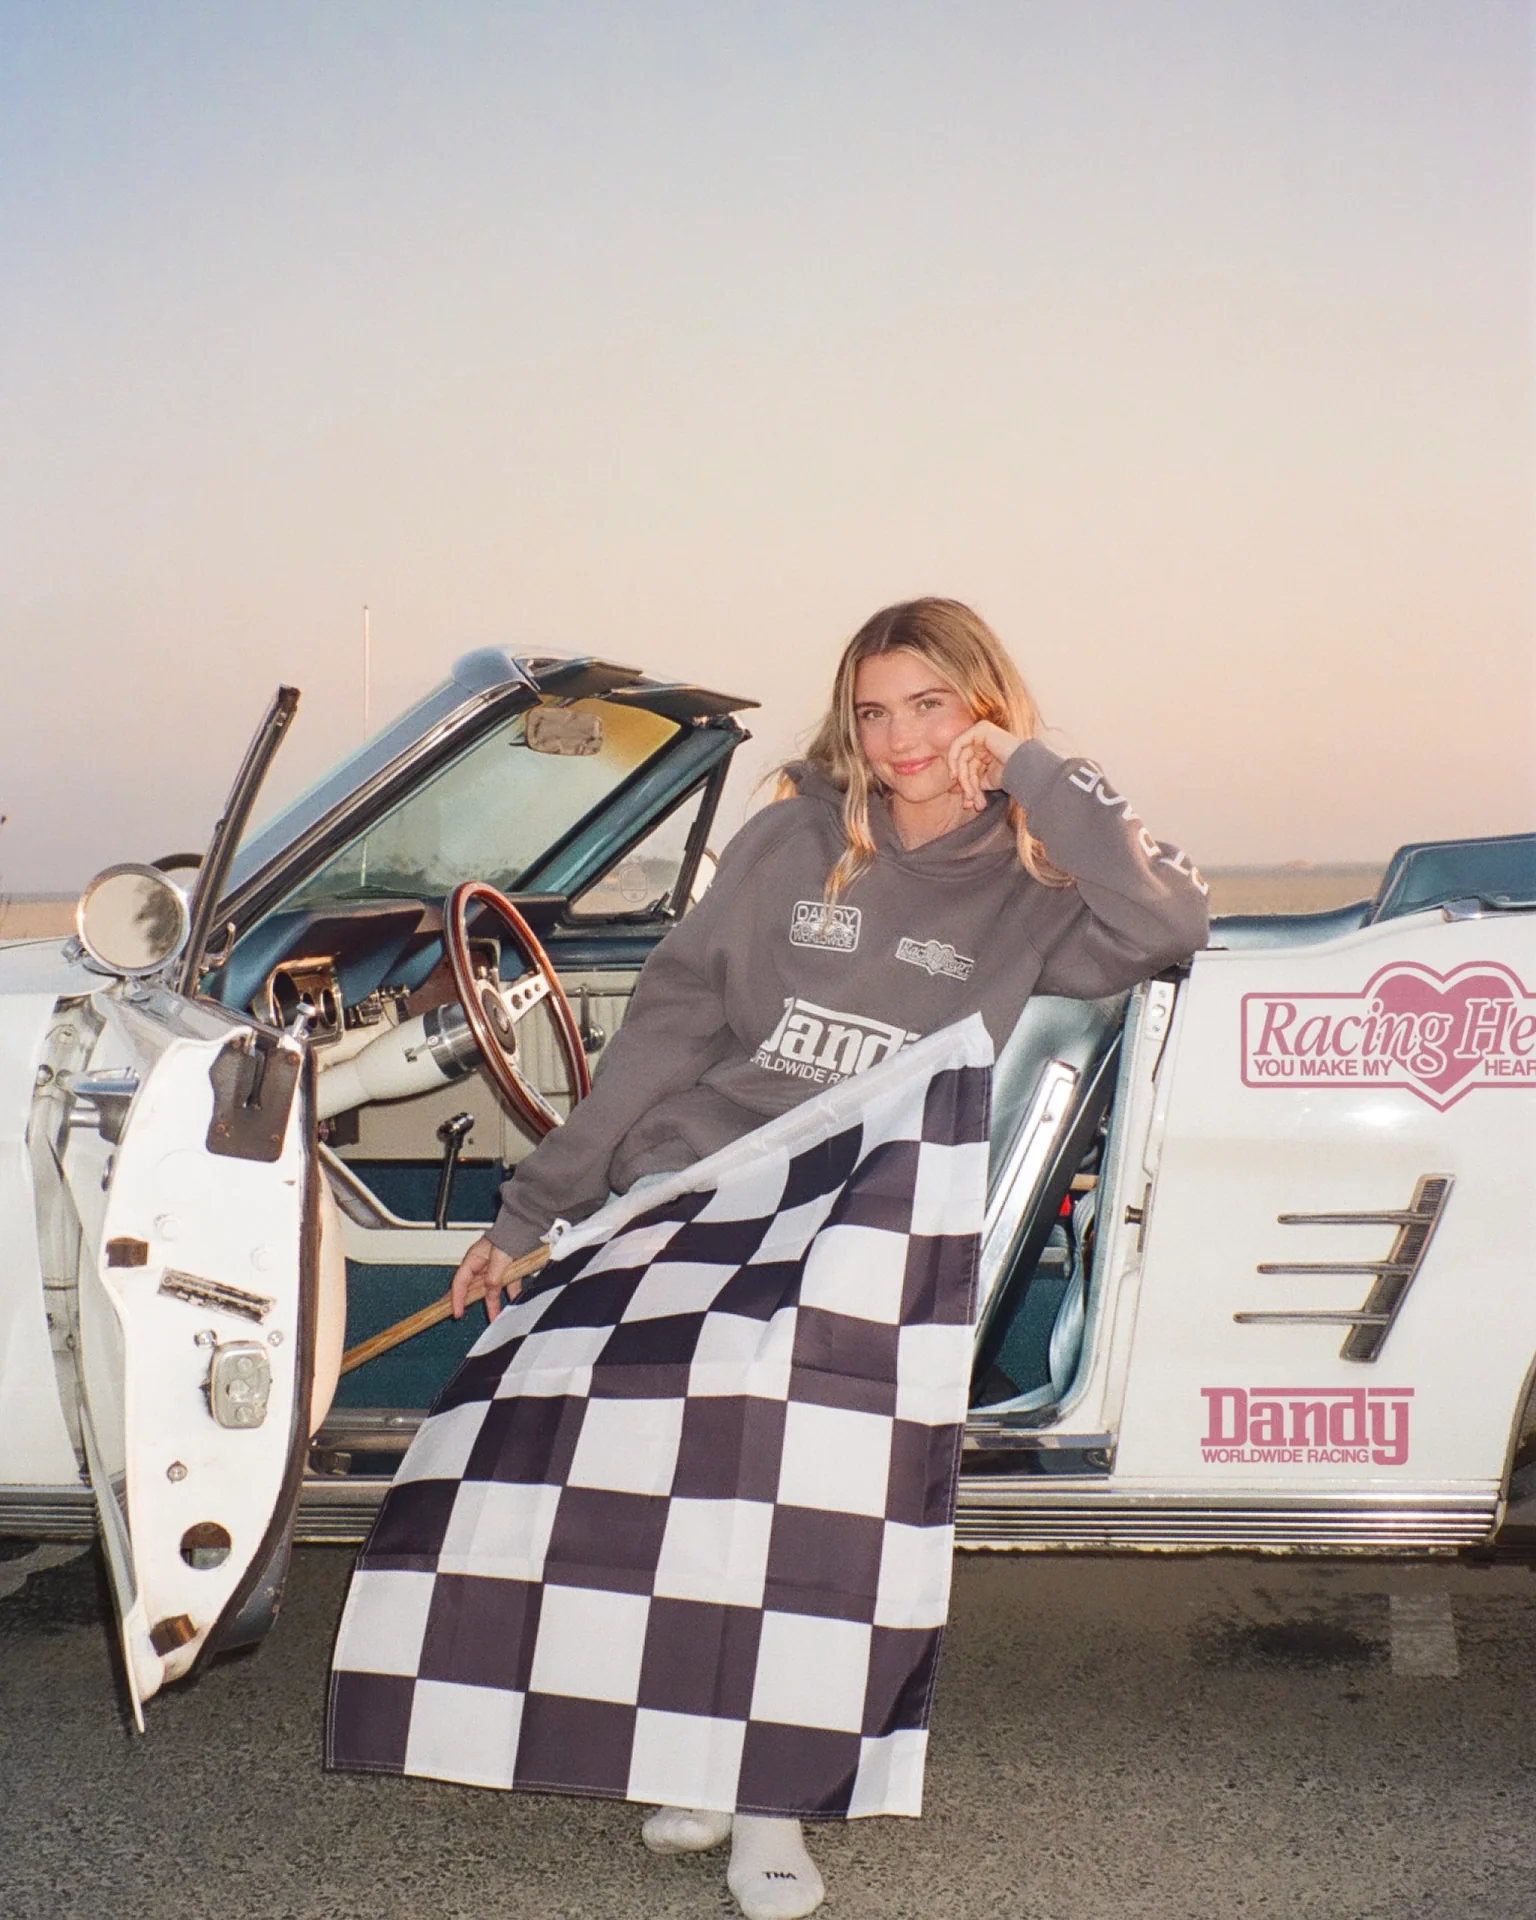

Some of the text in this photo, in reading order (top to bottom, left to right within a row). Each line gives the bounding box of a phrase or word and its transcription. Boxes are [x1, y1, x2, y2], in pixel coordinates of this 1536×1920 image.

[760, 997, 922, 1075] and
[1252, 1000, 1451, 1076] Racing
[750, 1051, 828, 1083] RLDWIDE
[1253, 1059, 1294, 1076] YOU
[1300, 1059, 1357, 1076] MAKE
[1363, 1059, 1393, 1076] MY
[1200, 1387, 1415, 1466] Dandy
[1202, 1449, 1369, 1463] WORLDWIDE RACING
